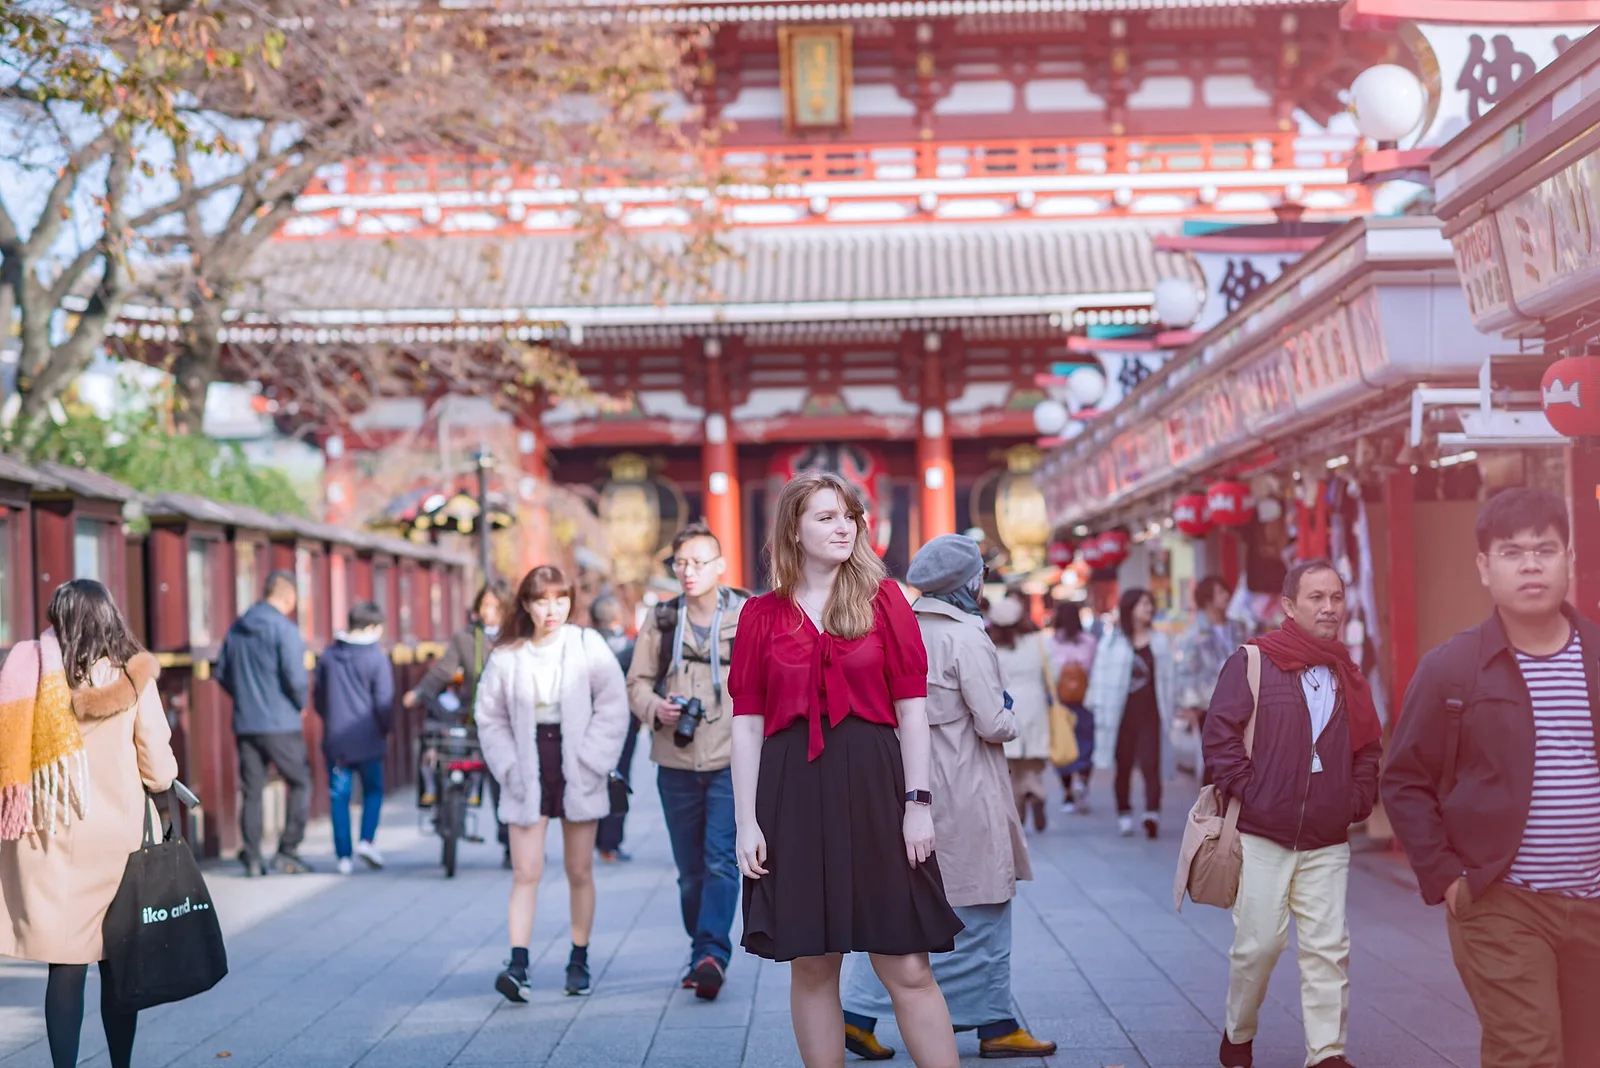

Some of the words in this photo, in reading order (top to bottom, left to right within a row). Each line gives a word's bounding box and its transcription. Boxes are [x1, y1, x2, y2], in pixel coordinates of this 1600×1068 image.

[1456, 33, 1587, 122] 仲
[1219, 260, 1291, 314] 仲
[143, 906, 168, 924] iko
